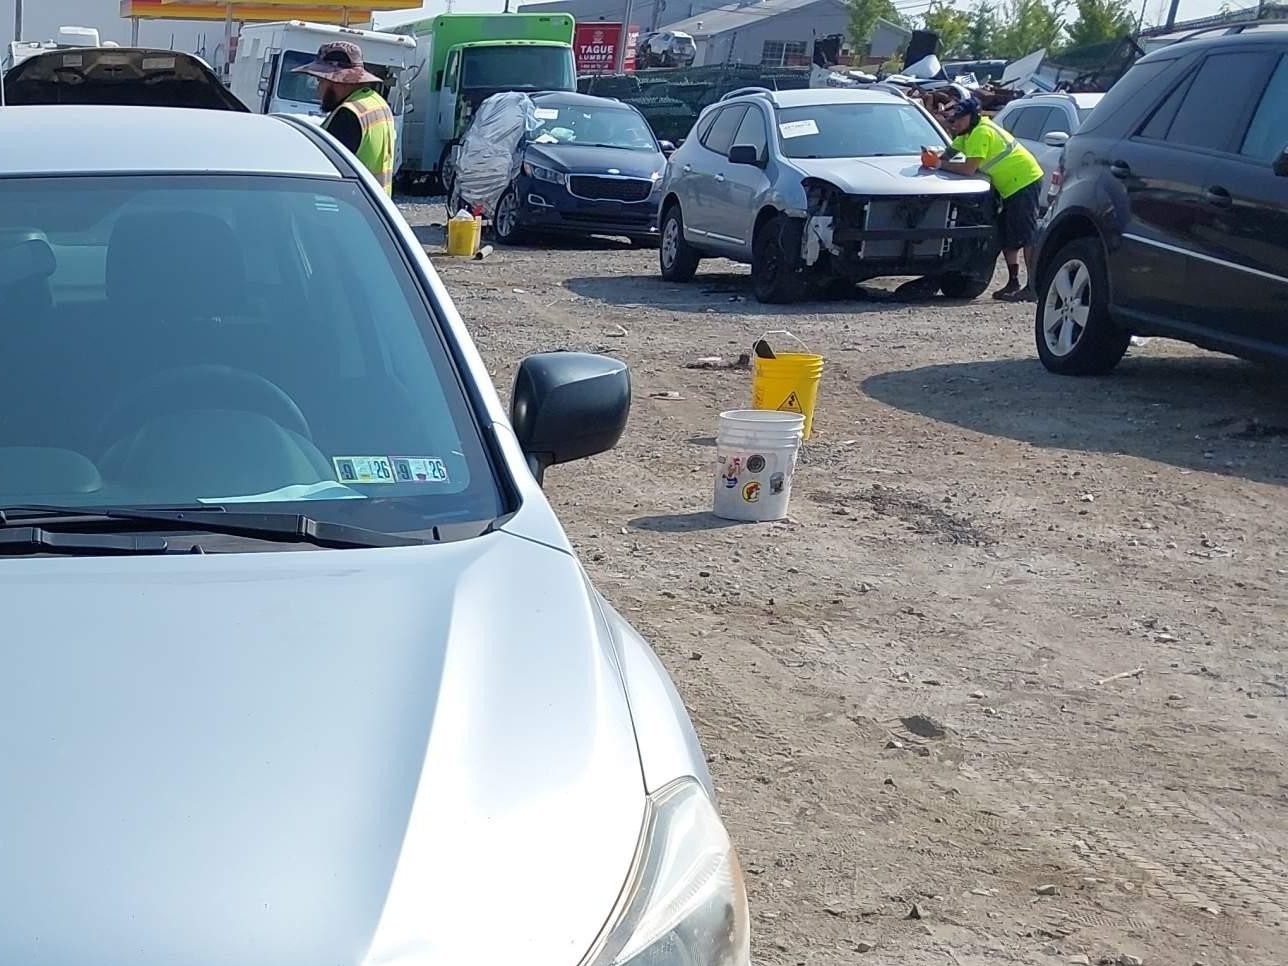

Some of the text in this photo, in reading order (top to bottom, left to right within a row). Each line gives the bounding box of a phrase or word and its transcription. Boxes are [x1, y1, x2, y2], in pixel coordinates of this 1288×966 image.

[580, 45, 614, 54] TAGUE
[373, 460, 391, 479] 26
[428, 460, 446, 479] 26
